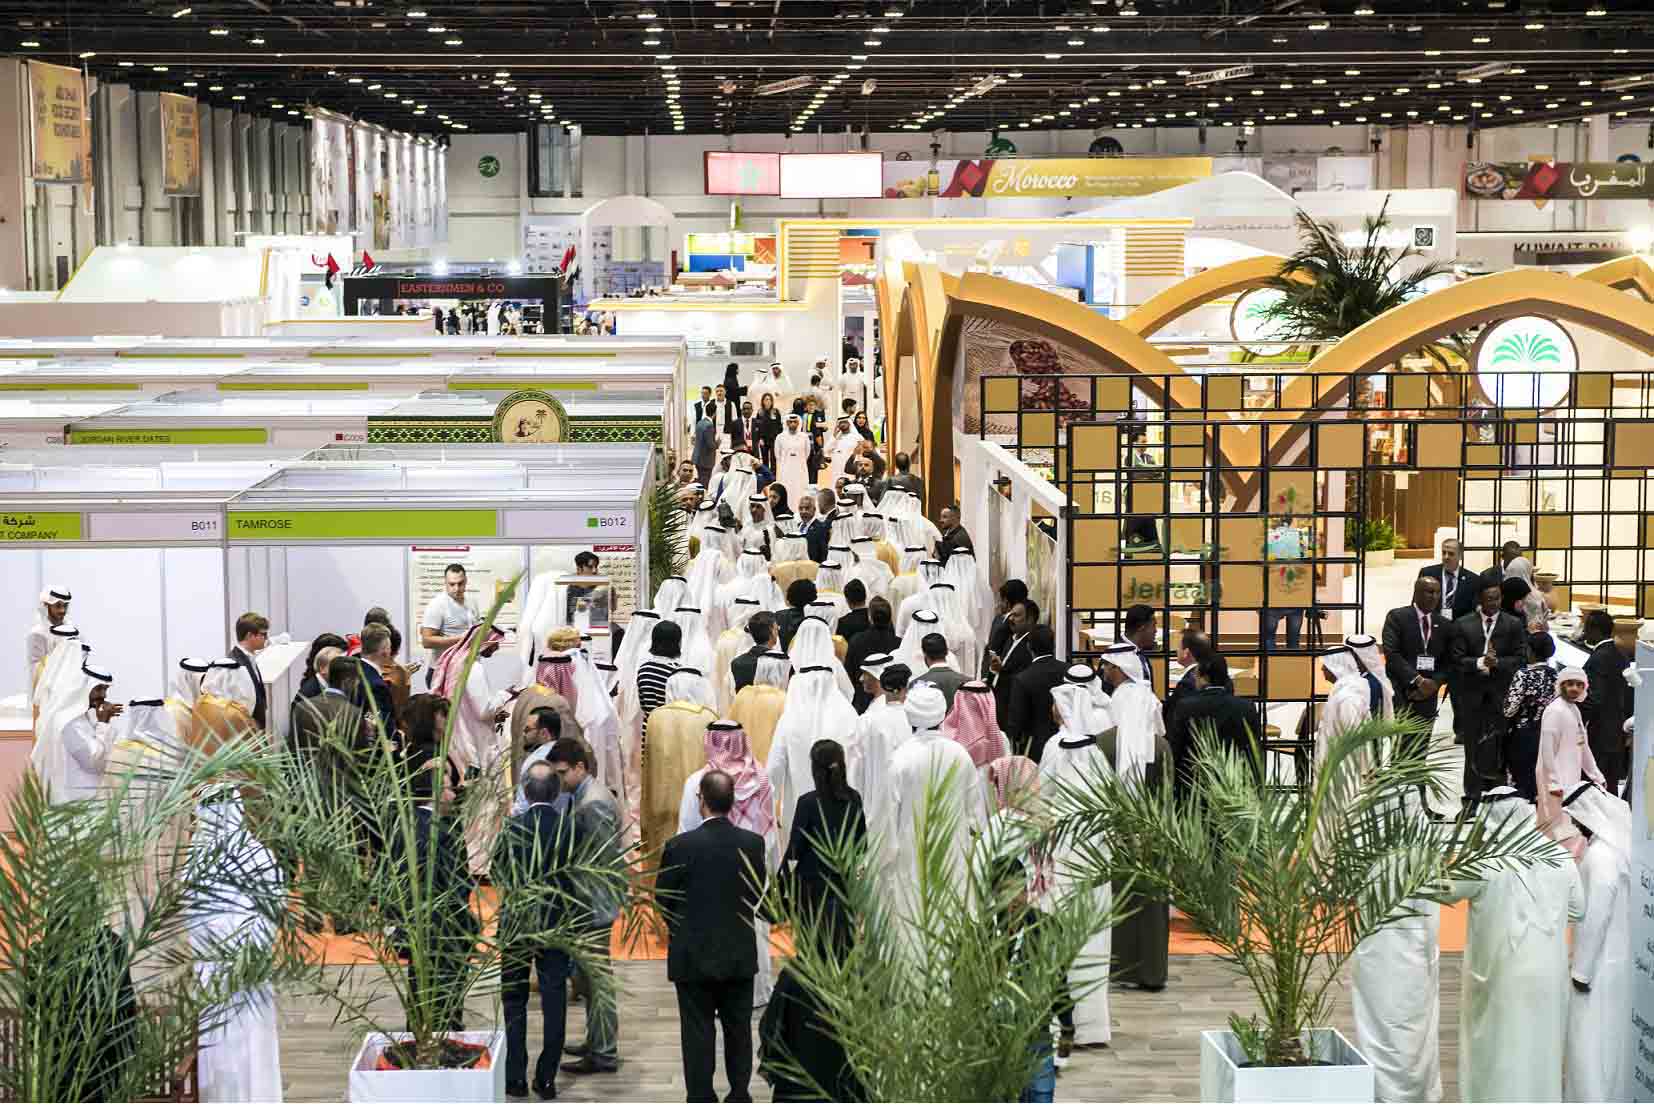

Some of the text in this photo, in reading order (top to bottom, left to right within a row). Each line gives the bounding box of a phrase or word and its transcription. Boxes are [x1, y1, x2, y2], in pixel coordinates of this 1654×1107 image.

[992, 164, 1077, 192] Morocco
[1570, 166, 1645, 196] المغرب
[487, 283, 504, 294] CO
[144, 435, 170, 443] DATES
[191, 521, 217, 531] B011
[236, 519, 293, 529] TAMROSE
[600, 517, 627, 527] B012
[8, 531, 57, 540] COMPANY
